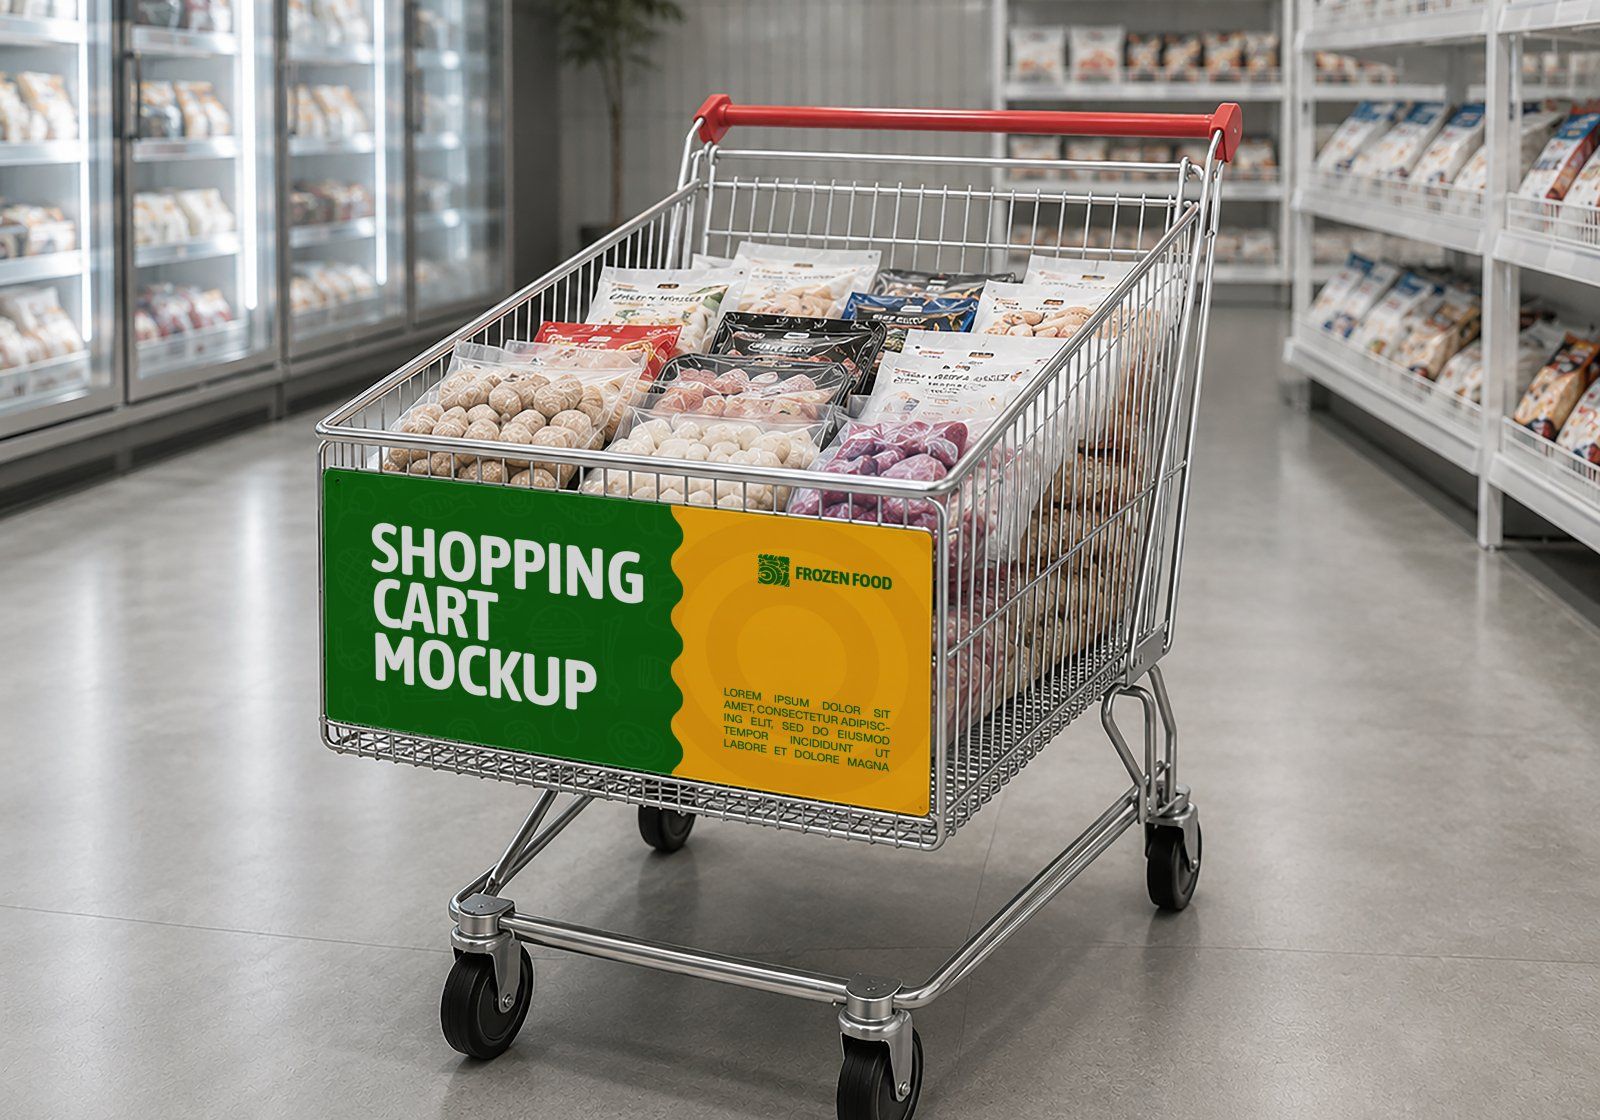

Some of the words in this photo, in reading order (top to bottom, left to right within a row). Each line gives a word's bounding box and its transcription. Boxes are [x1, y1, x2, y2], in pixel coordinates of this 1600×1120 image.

[371, 522, 644, 604] SHOPPING
[795, 566, 850, 586] FROZEN
[852, 573, 893, 591] FOOD
[373, 578, 499, 642] CART
[374, 631, 598, 710] MOCKUP
[723, 687, 763, 702] LOREM
[774, 694, 810, 708] IPSUM
[822, 701, 861, 716] DOLOR
[873, 708, 891, 719] SIT
[723, 700, 755, 714] AMET,
[756, 705, 838, 726] CONSECTETUR
[840, 717, 891, 732] ADIPISC-
[723, 713, 743, 724] ING
[781, 721, 804, 733] SED
[812, 725, 829, 737] DO
[837, 729, 891, 746] EIUSMOD
[723, 725, 769, 741] TEMPOR
[790, 735, 854, 753] INCIDIDUNT
[875, 748, 891, 759] UT
[723, 738, 767, 754] LABORE
[774, 745, 788, 757] ET
[794, 749, 840, 765] DOLORE
[847, 757, 890, 772] MAGNA
